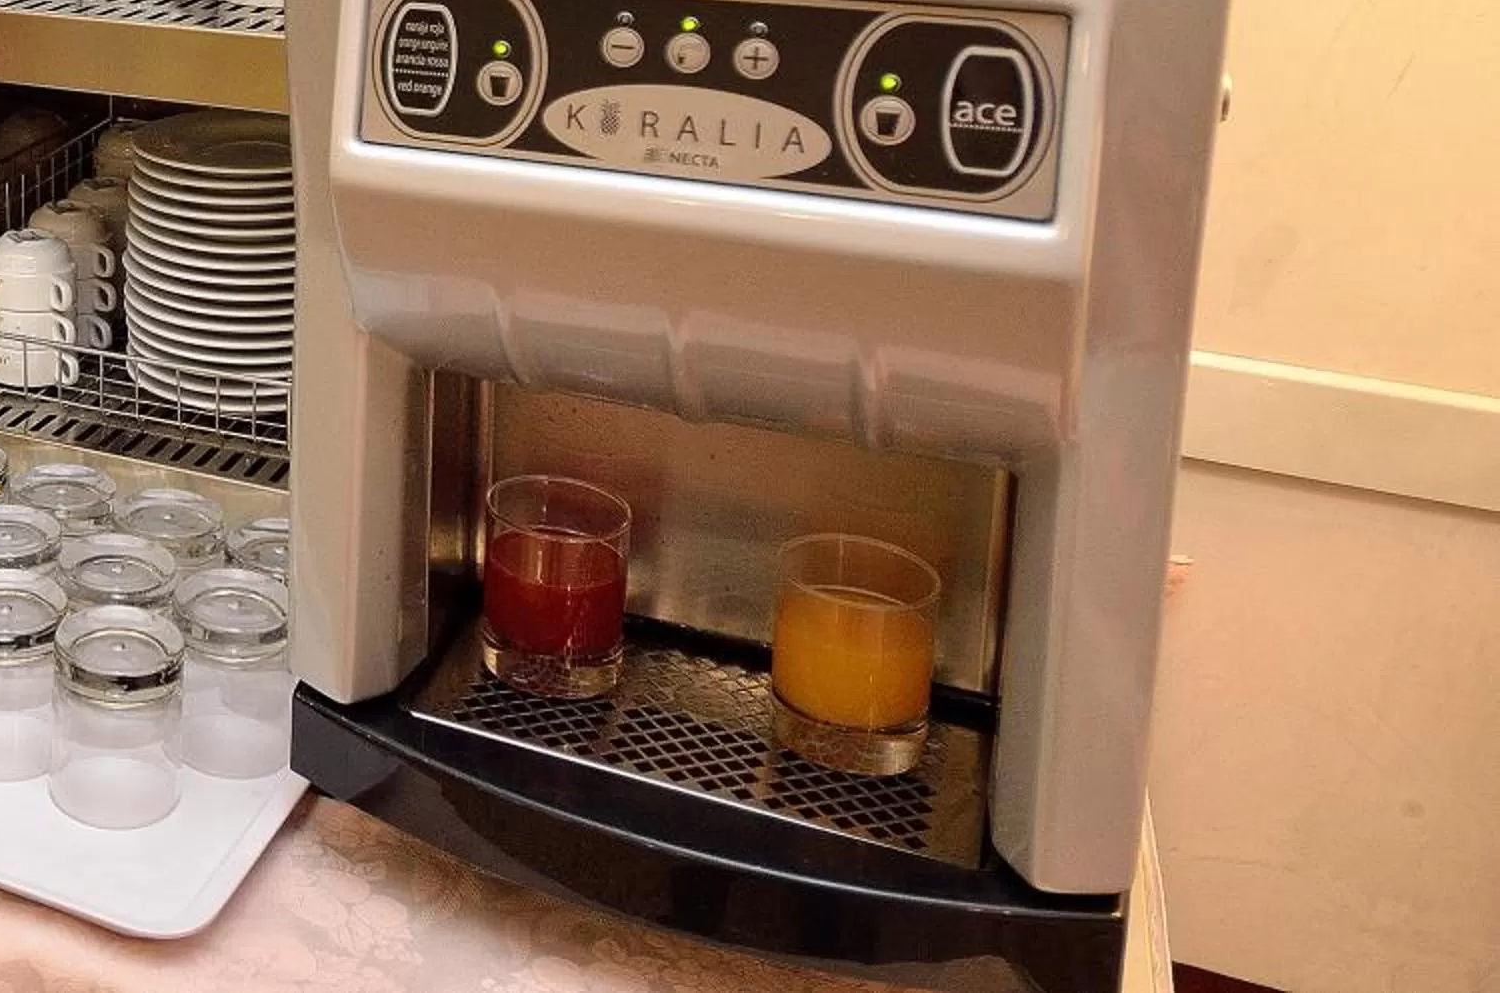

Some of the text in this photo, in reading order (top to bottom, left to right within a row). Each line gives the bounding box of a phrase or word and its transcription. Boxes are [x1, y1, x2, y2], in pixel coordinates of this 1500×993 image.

[953, 100, 1017, 126] ace
[566, 99, 805, 154] KRALIA
[669, 152, 720, 169] NECTA
